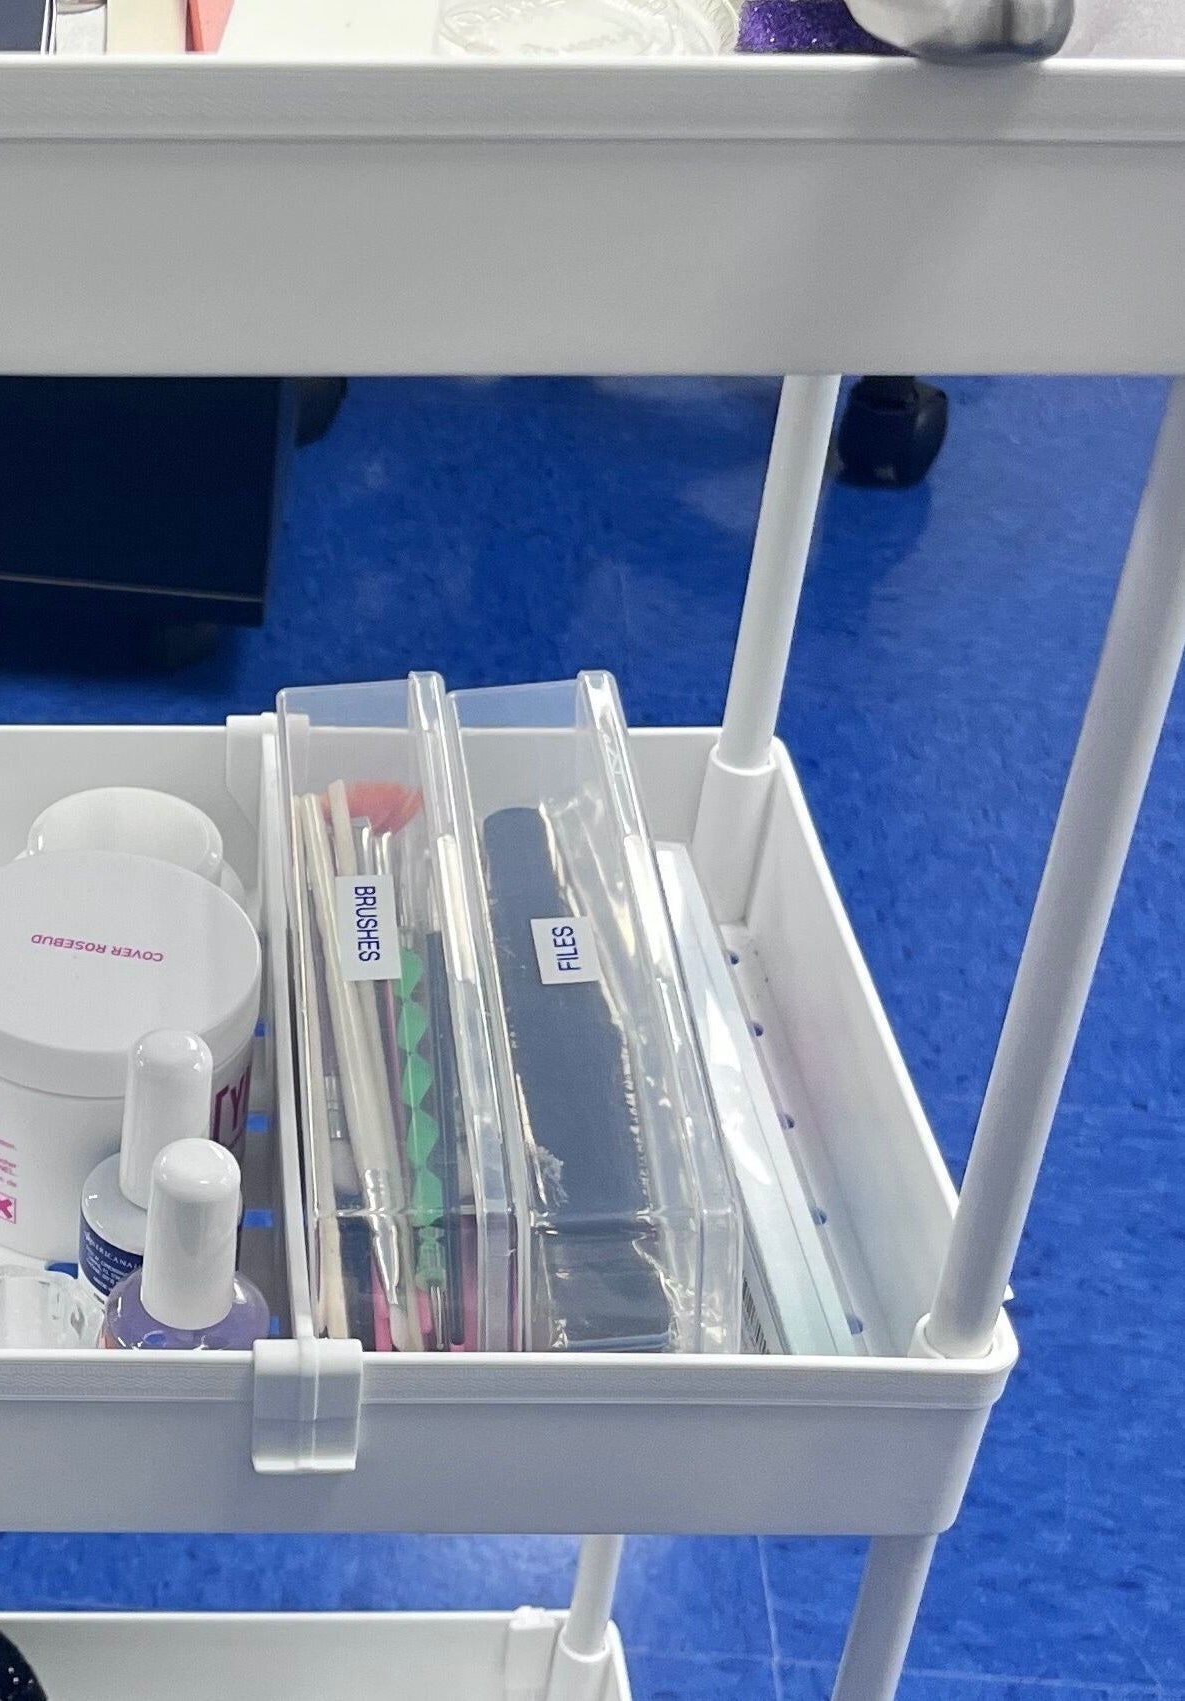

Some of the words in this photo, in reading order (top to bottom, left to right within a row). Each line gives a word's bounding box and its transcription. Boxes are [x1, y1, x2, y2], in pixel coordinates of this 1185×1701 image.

[354, 886, 380, 962] BRUSHES
[31, 934, 107, 954] ROSEBUD
[111, 945, 164, 962] COVER
[551, 925, 582, 972] FILES
